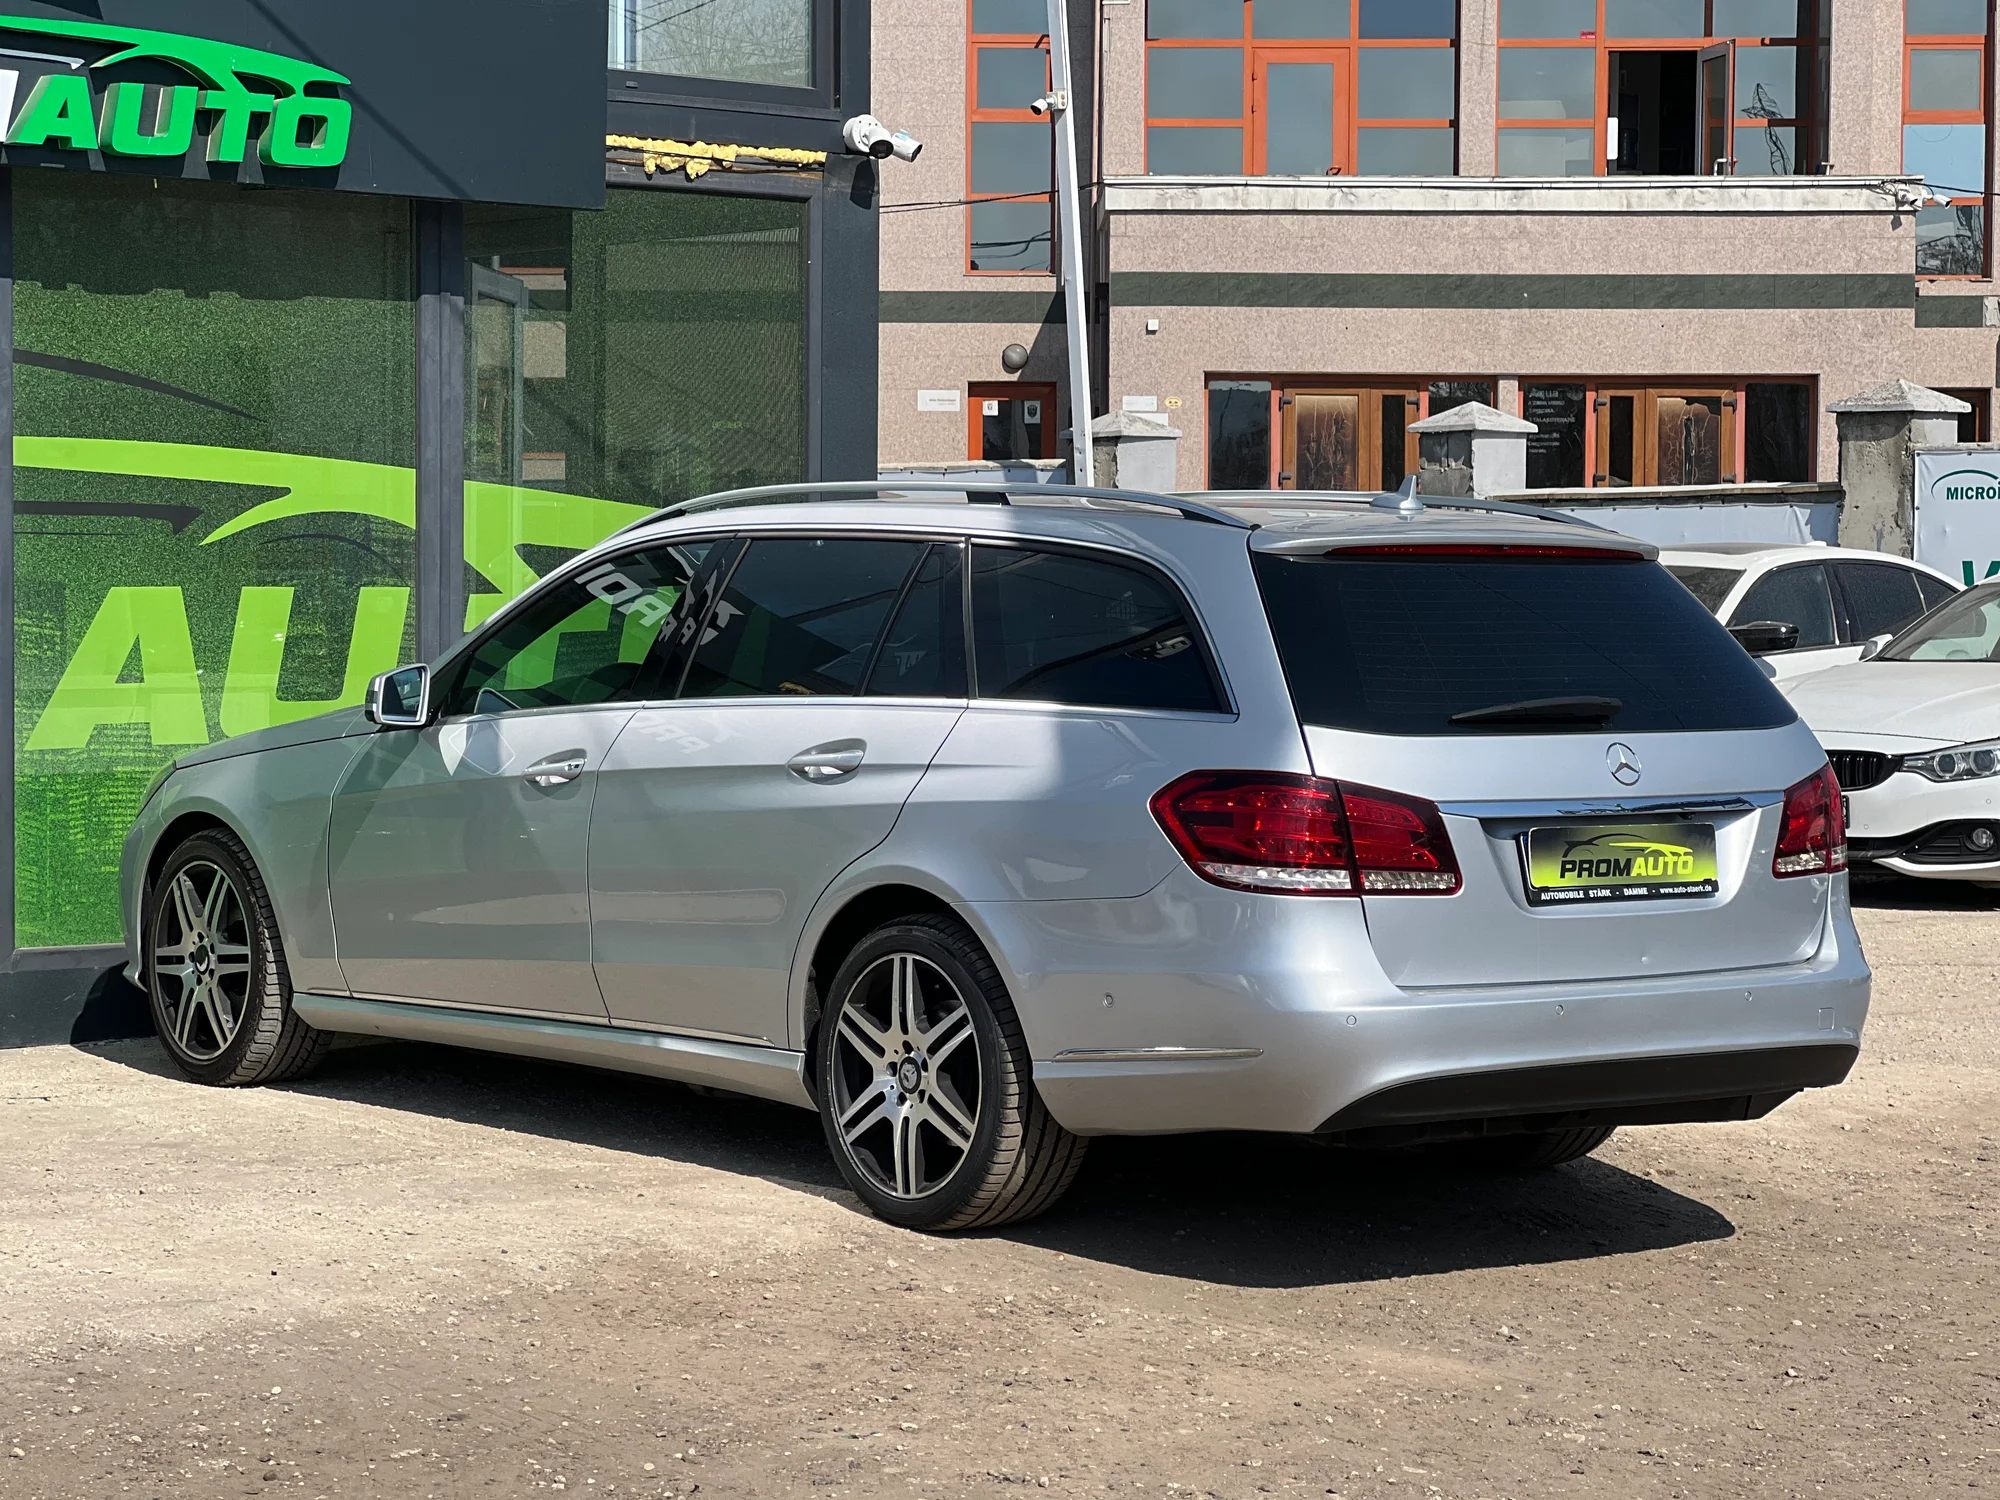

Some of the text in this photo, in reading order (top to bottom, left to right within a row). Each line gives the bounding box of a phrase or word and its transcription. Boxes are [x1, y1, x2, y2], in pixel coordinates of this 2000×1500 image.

[0, 68, 351, 168] AUTO
[1560, 856, 1694, 879] PROMAUTO
[1541, 890, 1584, 901] AUTOMOBILE
[1623, 888, 1648, 896] DAMME
[1660, 885, 1712, 894] www.auto-staerk.de
